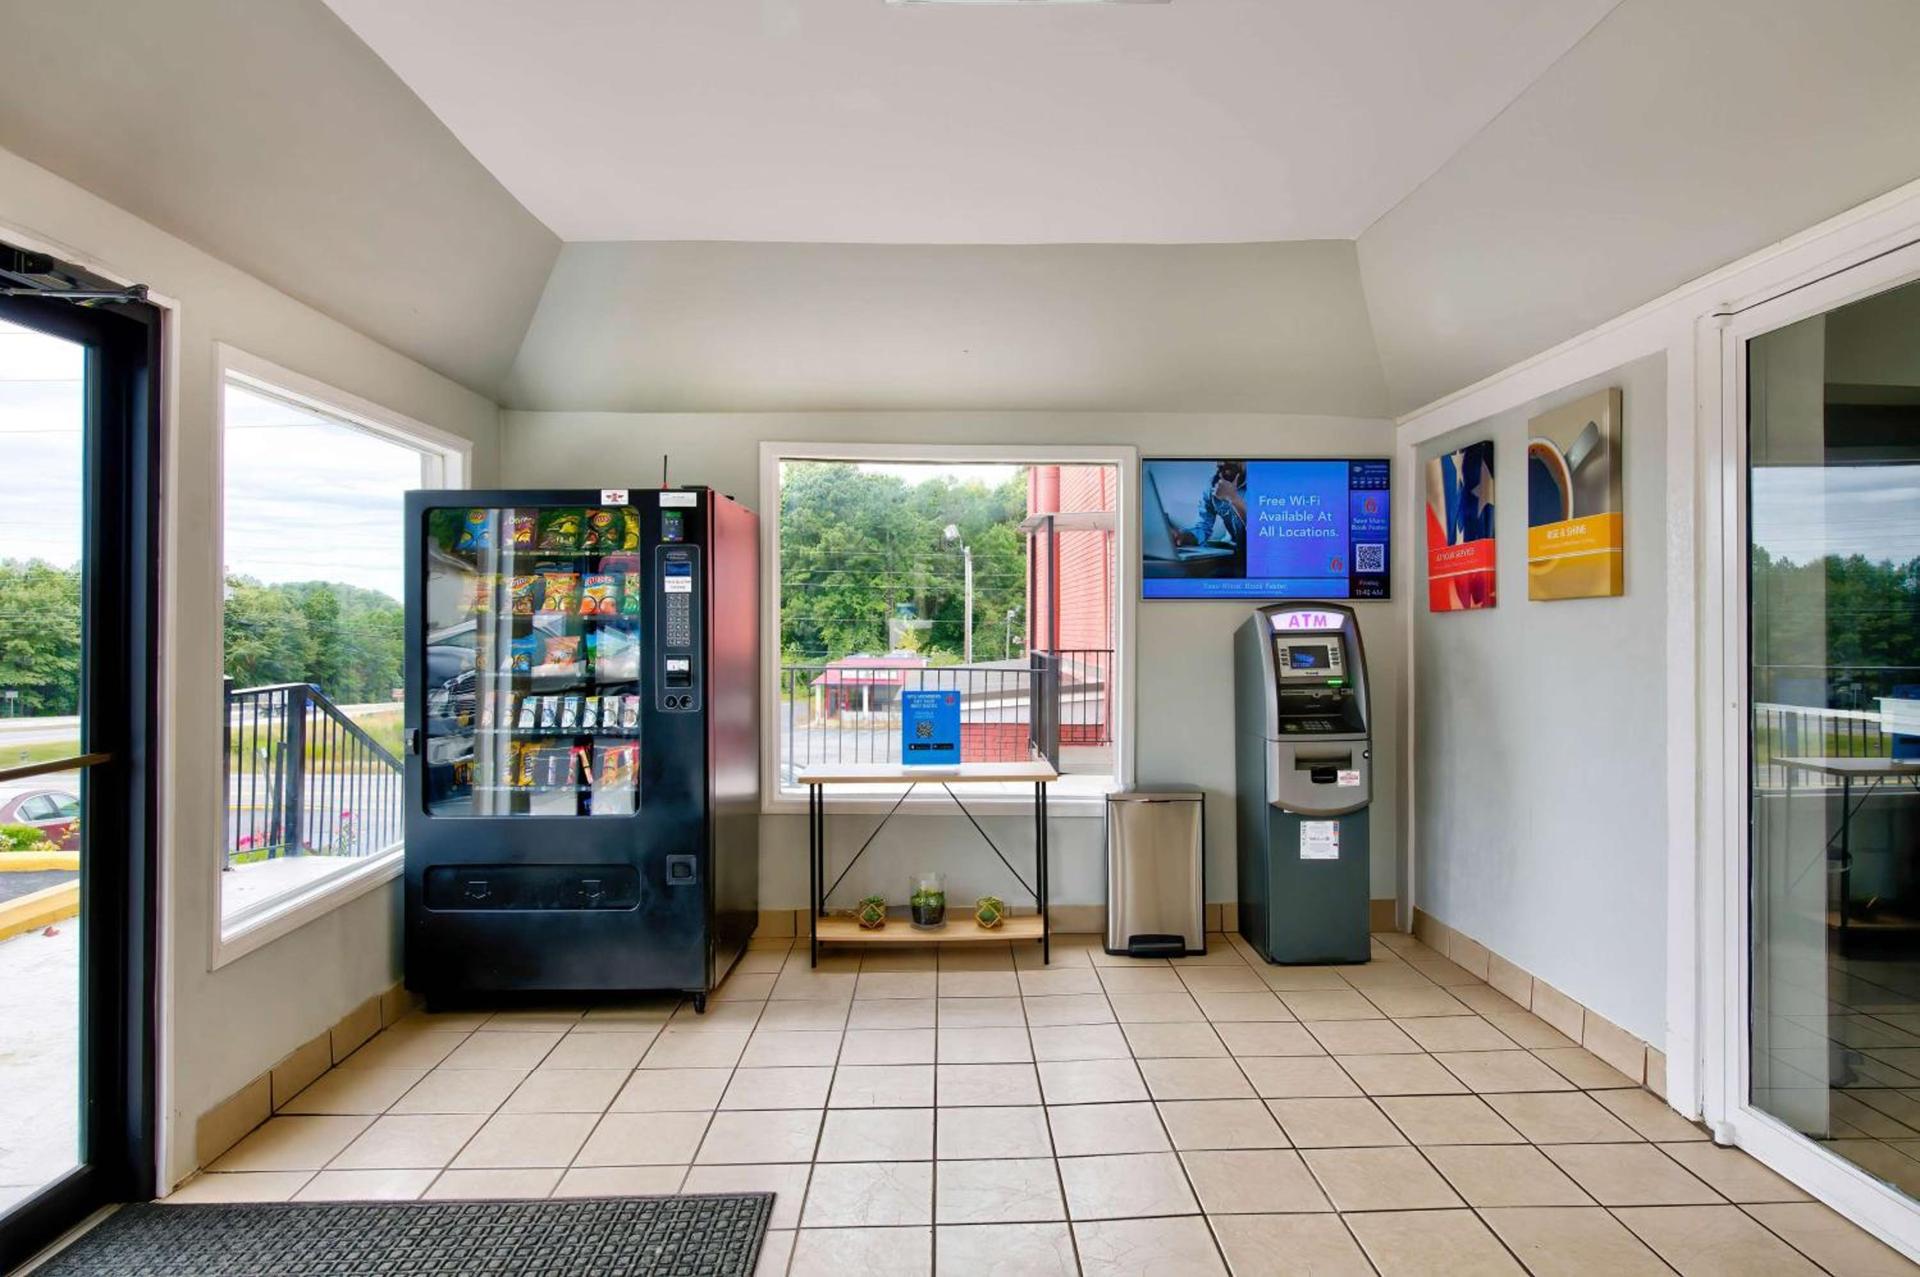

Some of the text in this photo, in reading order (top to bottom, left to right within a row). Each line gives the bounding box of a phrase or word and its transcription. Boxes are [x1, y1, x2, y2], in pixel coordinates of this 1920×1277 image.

[1259, 496, 1321, 507] Free Wi-Fi
[1259, 511, 1332, 522] Available At
[1259, 526, 1339, 537] All Locations.
[1566, 525, 1587, 536] SHINE
[1288, 614, 1327, 627] ATM
